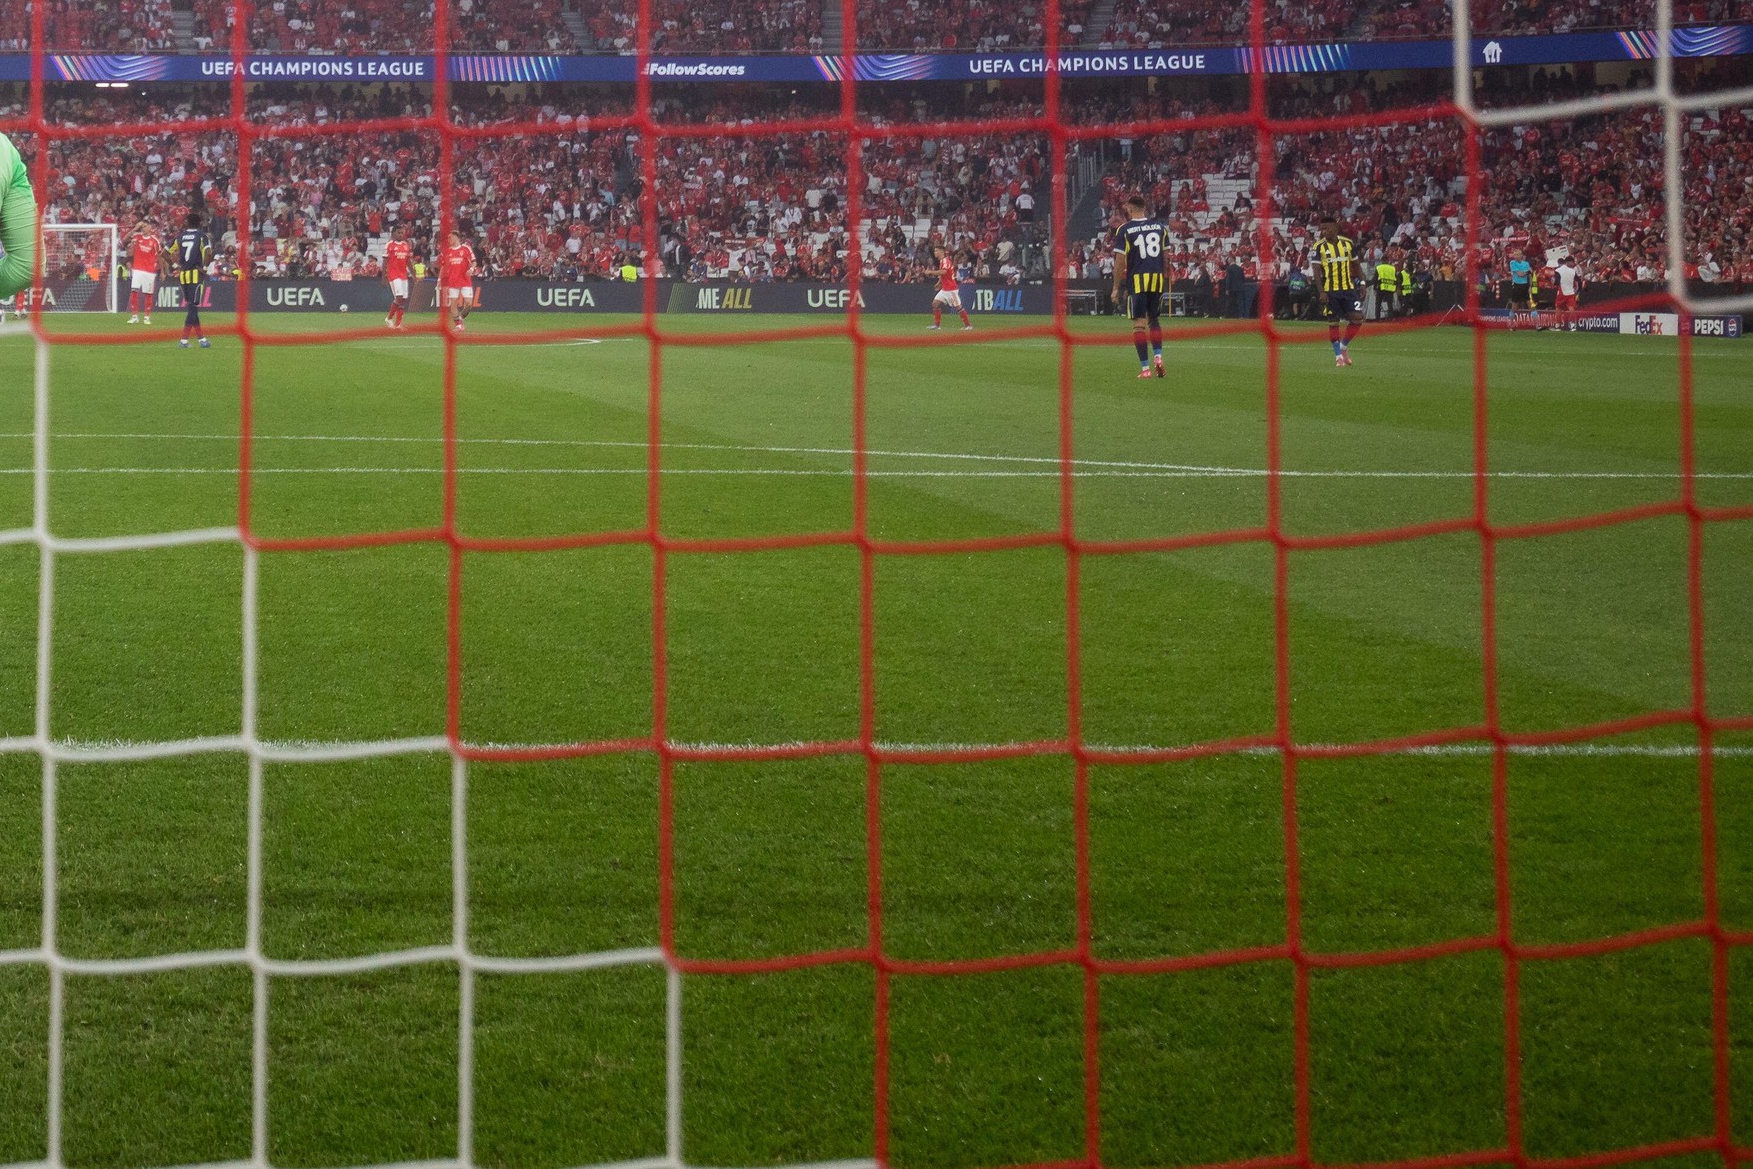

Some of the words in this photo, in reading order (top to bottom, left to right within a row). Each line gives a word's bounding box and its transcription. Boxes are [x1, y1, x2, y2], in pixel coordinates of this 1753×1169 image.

[201, 61, 245, 75] UEFA
[249, 61, 353, 76] CHAMPIONS
[357, 61, 424, 76] LEAGUE
[969, 58, 1014, 73] UEFA
[1019, 56, 1129, 73] CHAMPIONS
[1133, 54, 1205, 71] LEAGUE
[181, 241, 195, 262] 7
[1133, 232, 1161, 259] 18
[266, 287, 325, 306] UEFA
[537, 288, 595, 307] UEFA
[721, 288, 753, 309] ALL
[807, 288, 866, 308] UEFA
[1578, 316, 1618, 332] crypto.com
[1634, 314, 1663, 336] FedEx
[1694, 319, 1724, 336] PEPSI
